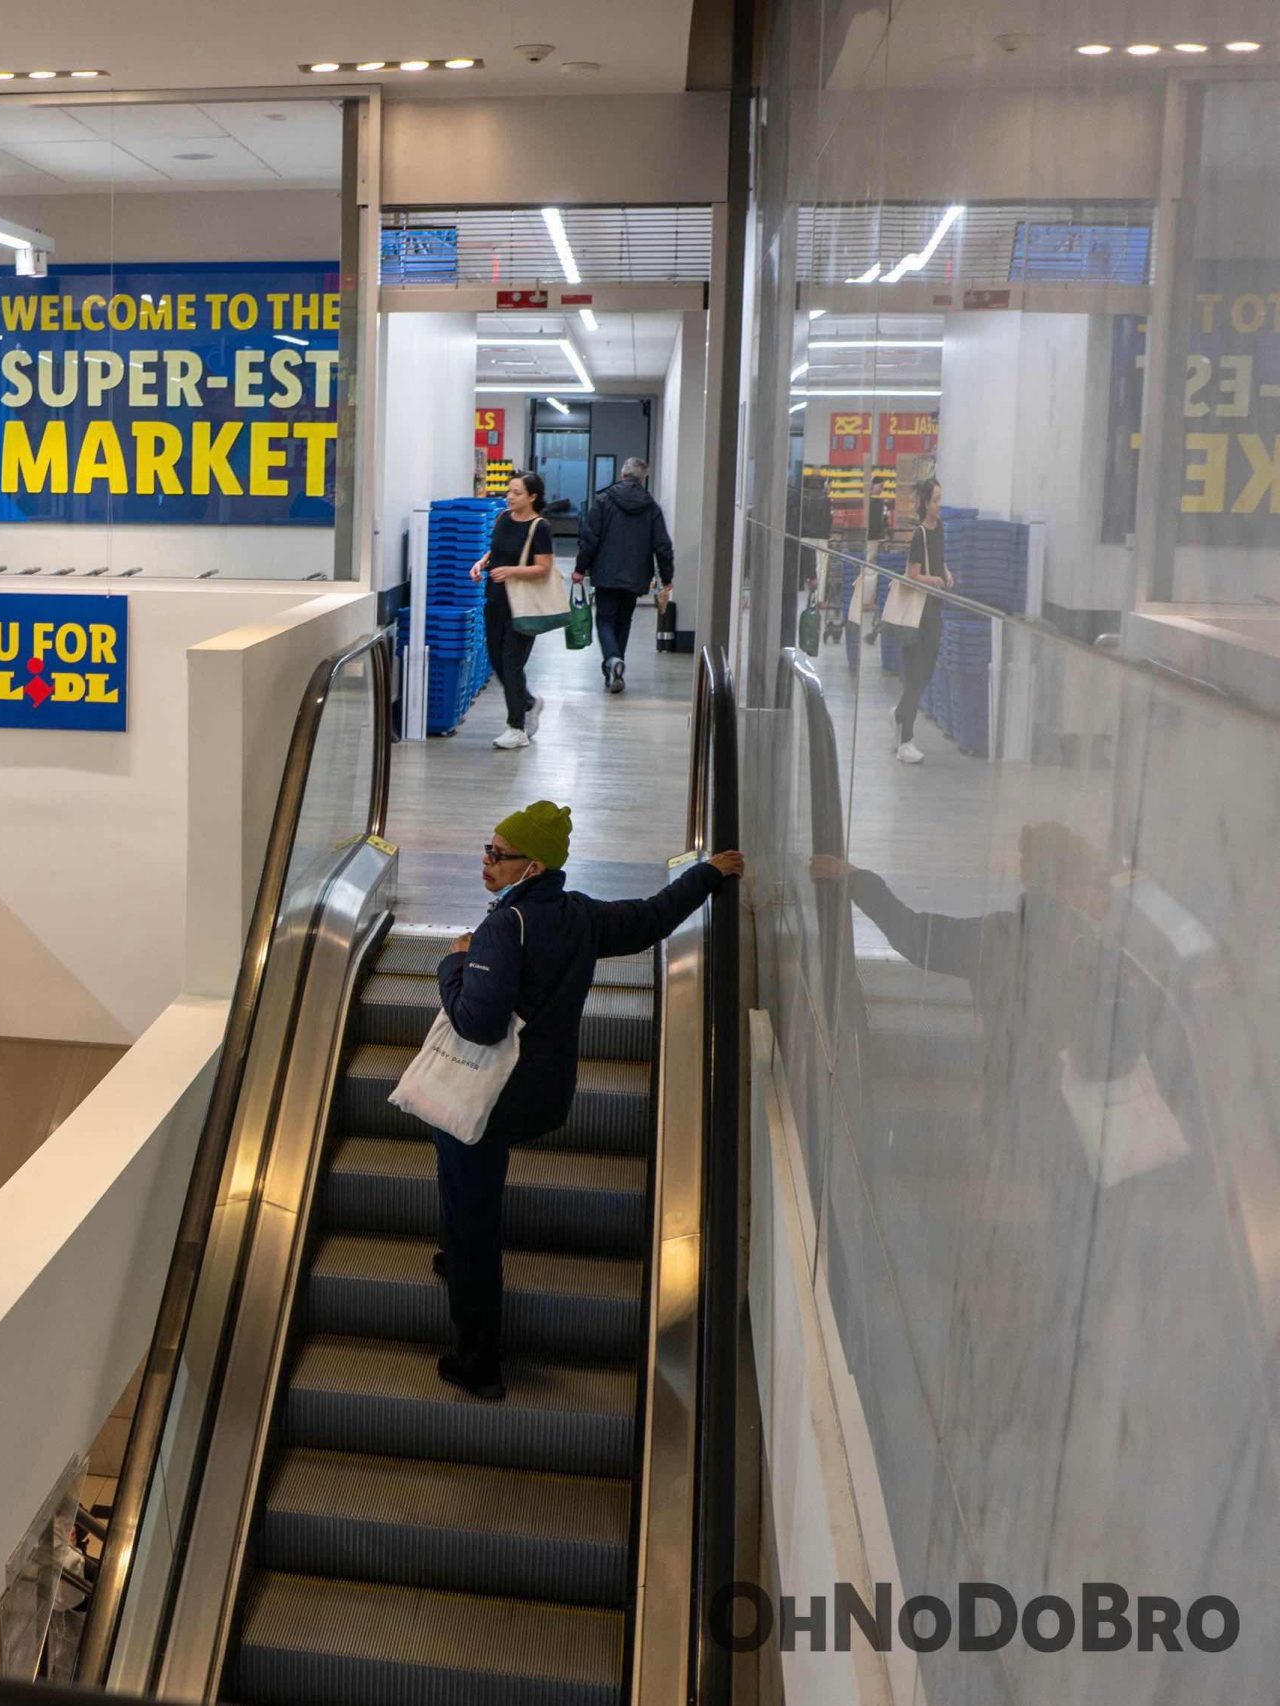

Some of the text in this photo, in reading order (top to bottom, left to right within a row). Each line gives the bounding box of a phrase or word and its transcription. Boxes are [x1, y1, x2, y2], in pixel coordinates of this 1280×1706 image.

[1, 293, 340, 332] WELCOME TO THE
[0, 349, 340, 408] SUPER-EST
[1, 420, 338, 497] MARKET
[32, 622, 118, 664] FOR
